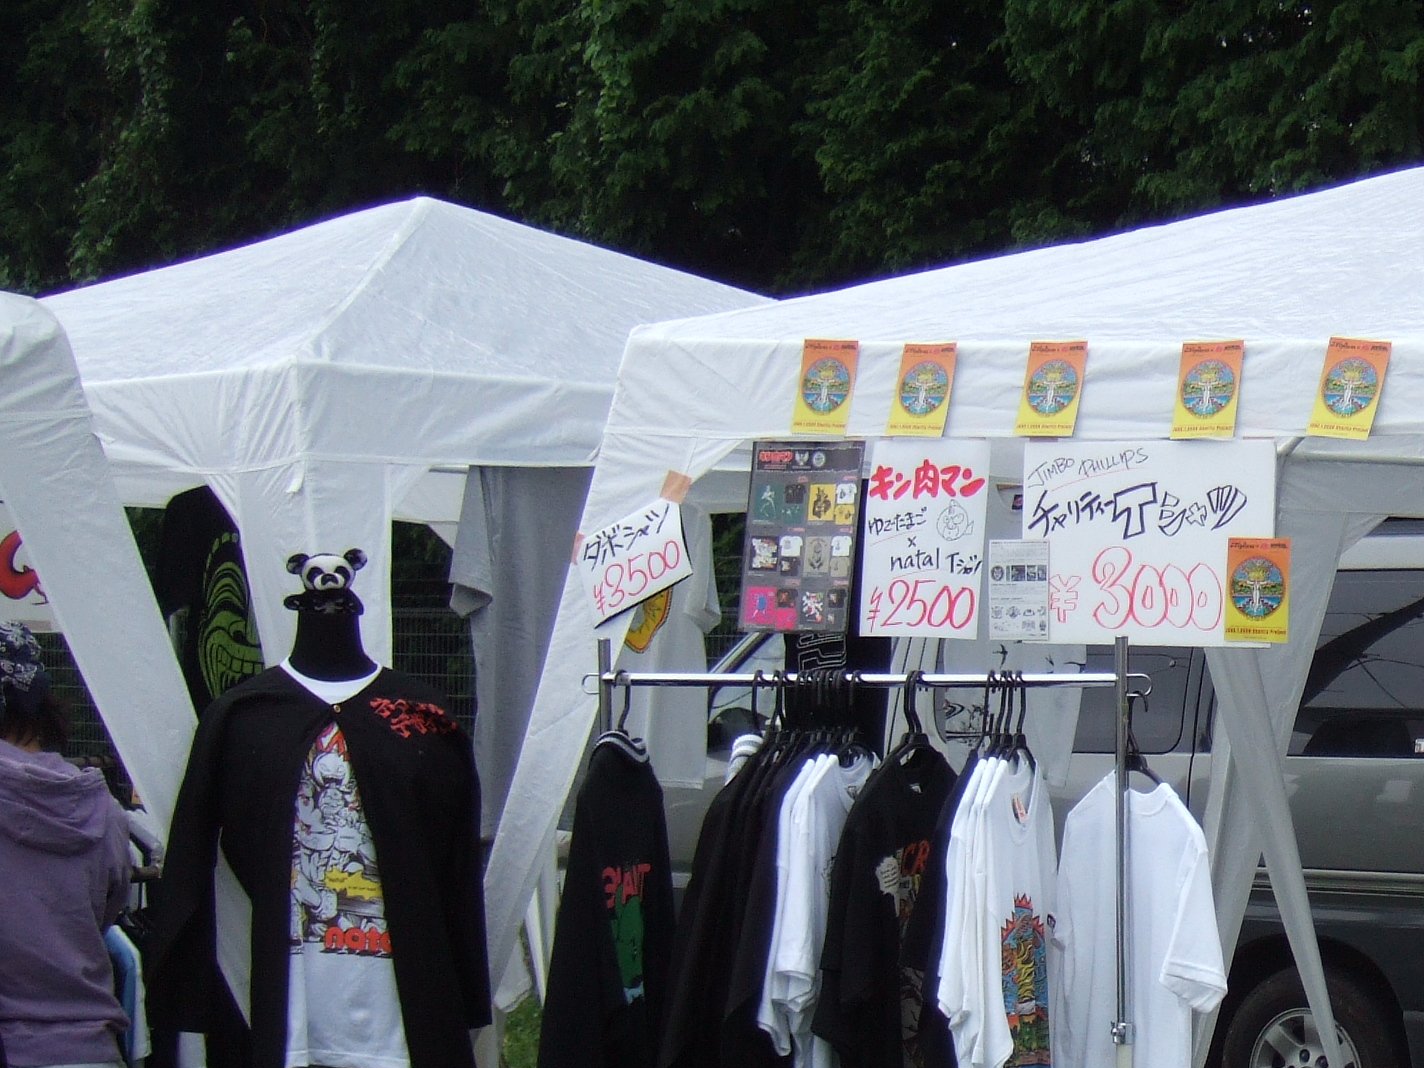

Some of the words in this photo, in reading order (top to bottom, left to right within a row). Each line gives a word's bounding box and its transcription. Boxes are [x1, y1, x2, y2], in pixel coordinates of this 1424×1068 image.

[869, 459, 985, 500] キン肉マン
[1027, 458, 1075, 488] JIMBO
[1078, 447, 1149, 478] PHILLIPS
[583, 503, 670, 571] ダボシャツ
[890, 548, 940, 572] natal
[593, 541, 680, 616] ¥3500
[868, 579, 974, 631] ¥2500
